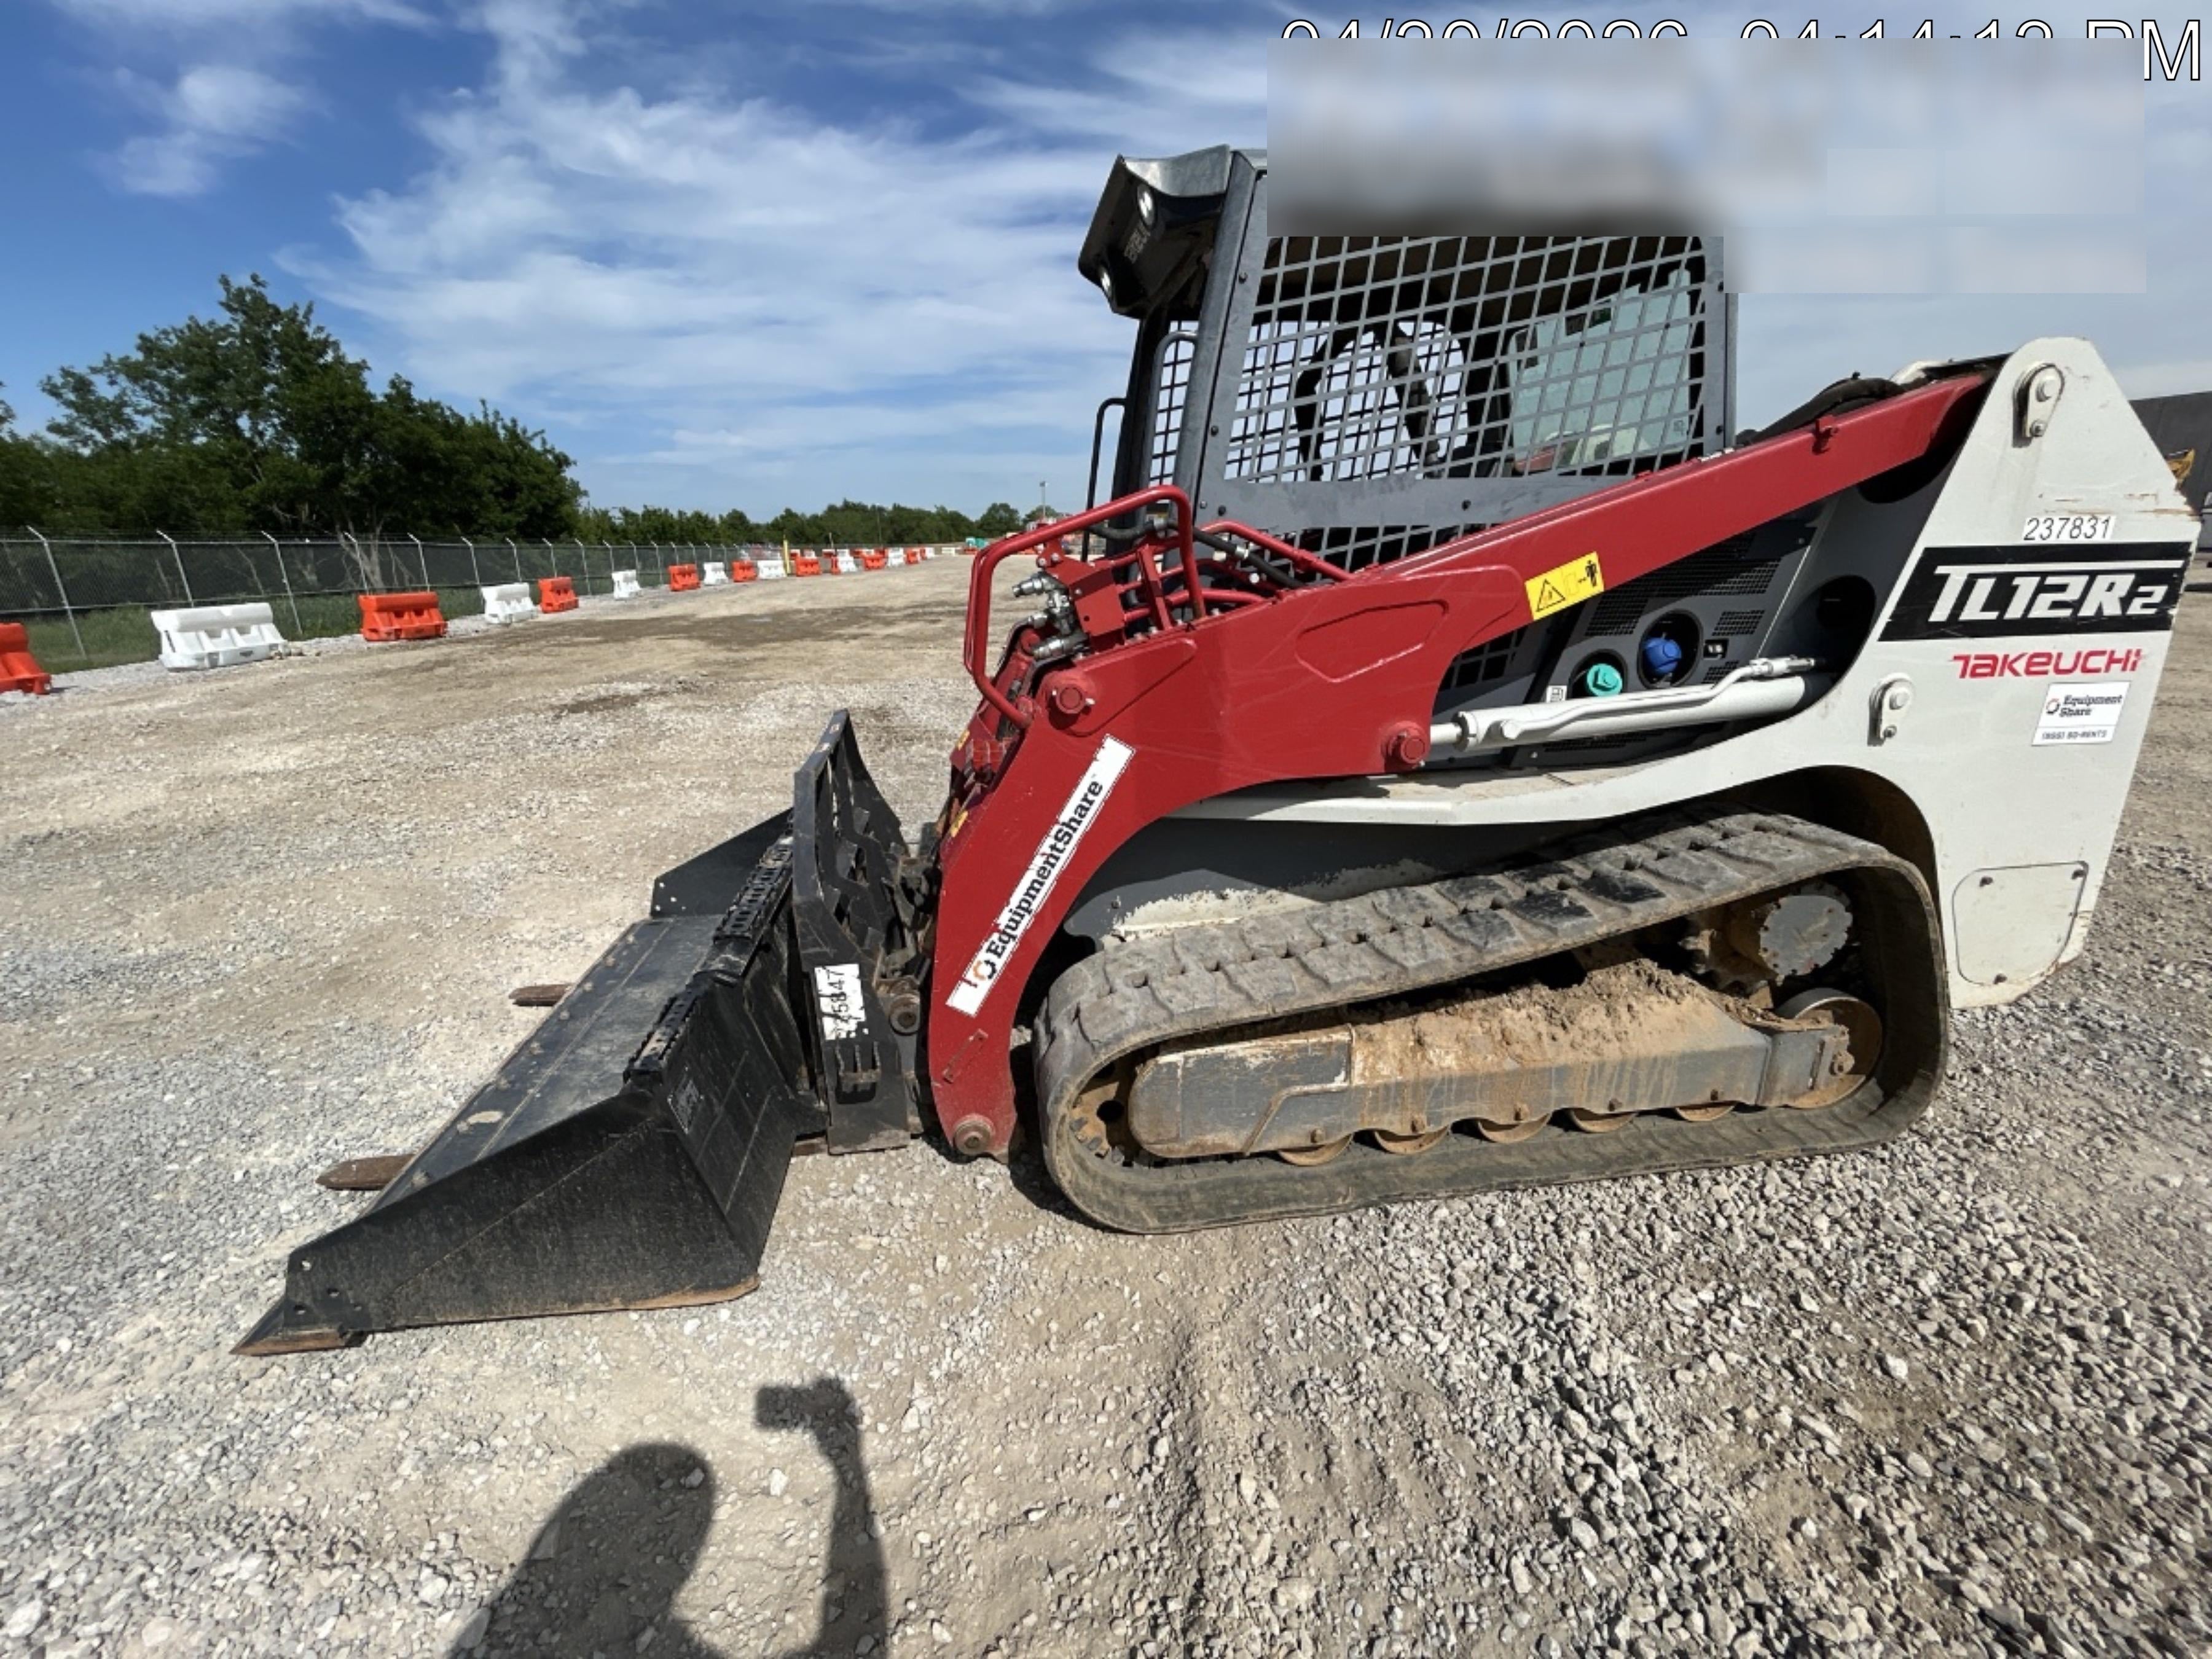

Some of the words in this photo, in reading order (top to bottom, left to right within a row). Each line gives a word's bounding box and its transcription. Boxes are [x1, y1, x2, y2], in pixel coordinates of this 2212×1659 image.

[2023, 516, 2112, 541] 237831
[2063, 694, 2123, 706] Equipment
[2060, 708, 2092, 717] Share
[986, 780, 1103, 959] EquipmentShare
